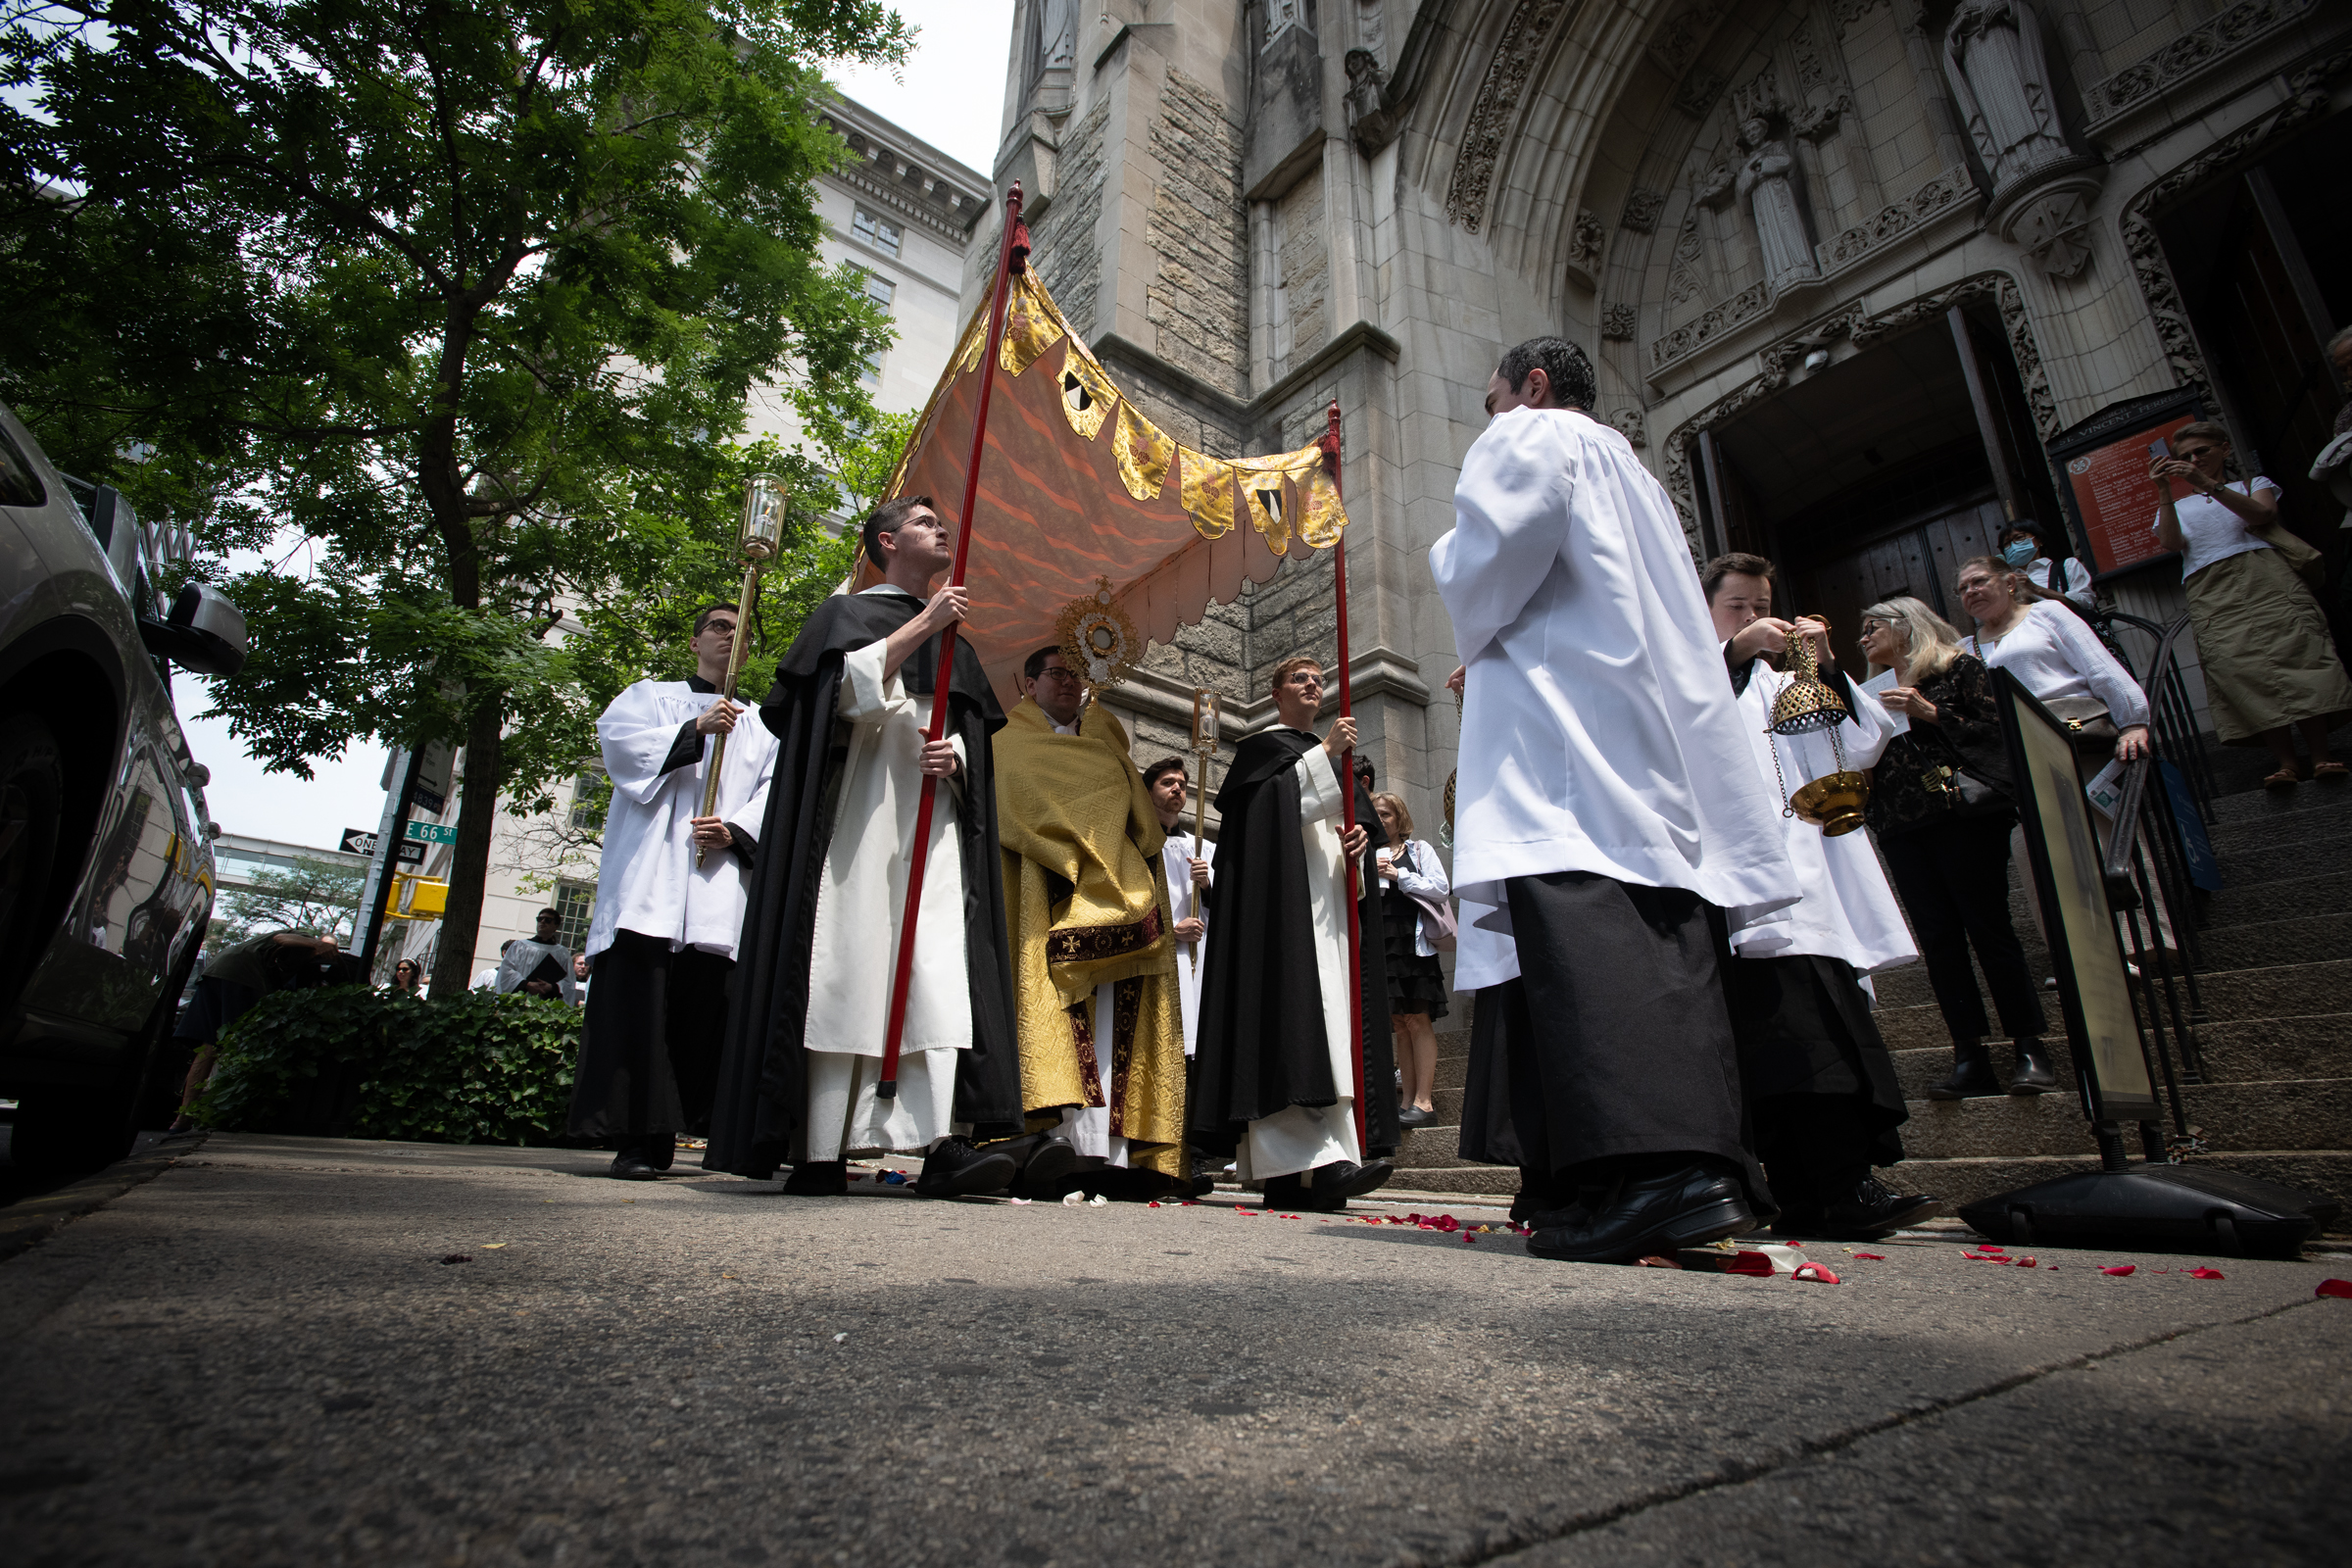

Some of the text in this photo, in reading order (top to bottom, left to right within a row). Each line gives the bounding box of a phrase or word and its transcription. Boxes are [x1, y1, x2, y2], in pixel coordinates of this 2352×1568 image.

[2059, 392, 2183, 446] ST. VINCENT FERRER
[406, 822, 453, 840] E 66 St
[355, 838, 377, 850] ONE
